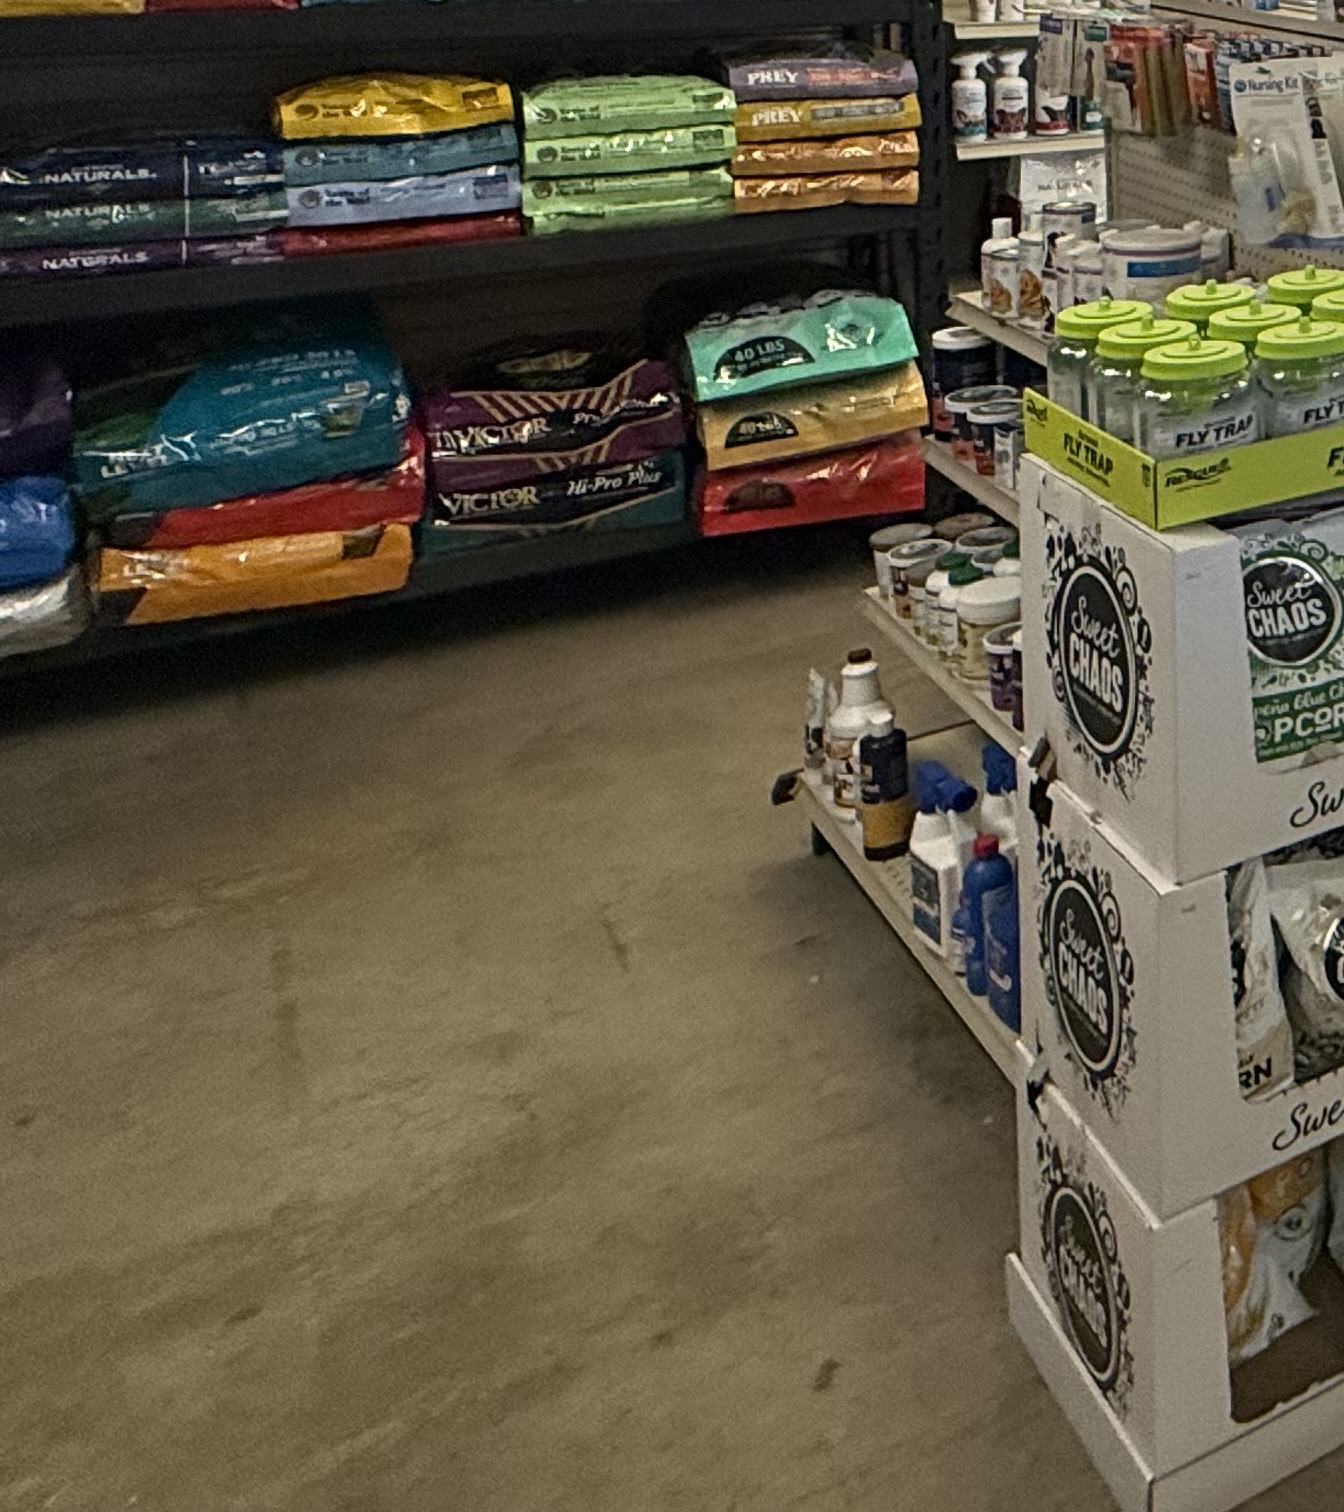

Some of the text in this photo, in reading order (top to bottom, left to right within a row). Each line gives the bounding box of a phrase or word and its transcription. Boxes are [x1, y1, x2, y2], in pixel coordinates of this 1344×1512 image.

[747, 71, 799, 86] PREY
[751, 108, 803, 126] PREY
[734, 339, 786, 362] 40 LBS
[1175, 428, 1211, 449] FLY
[1213, 414, 1254, 441] TRAP
[1303, 404, 1335, 425] FLY
[1063, 433, 1083, 461] FLY
[1084, 444, 1114, 478] TRAP
[438, 485, 541, 517] VICTOR
[566, 475, 623, 497] Hi-Pro
[1247, 578, 1312, 608] Sweet
[1069, 594, 1121, 659] Sweet
[1247, 598, 1328, 638] CHAOS
[1068, 629, 1124, 717] CHAOS
[1058, 908, 1106, 979] Sweet
[1055, 947, 1109, 1037] CHAOS
